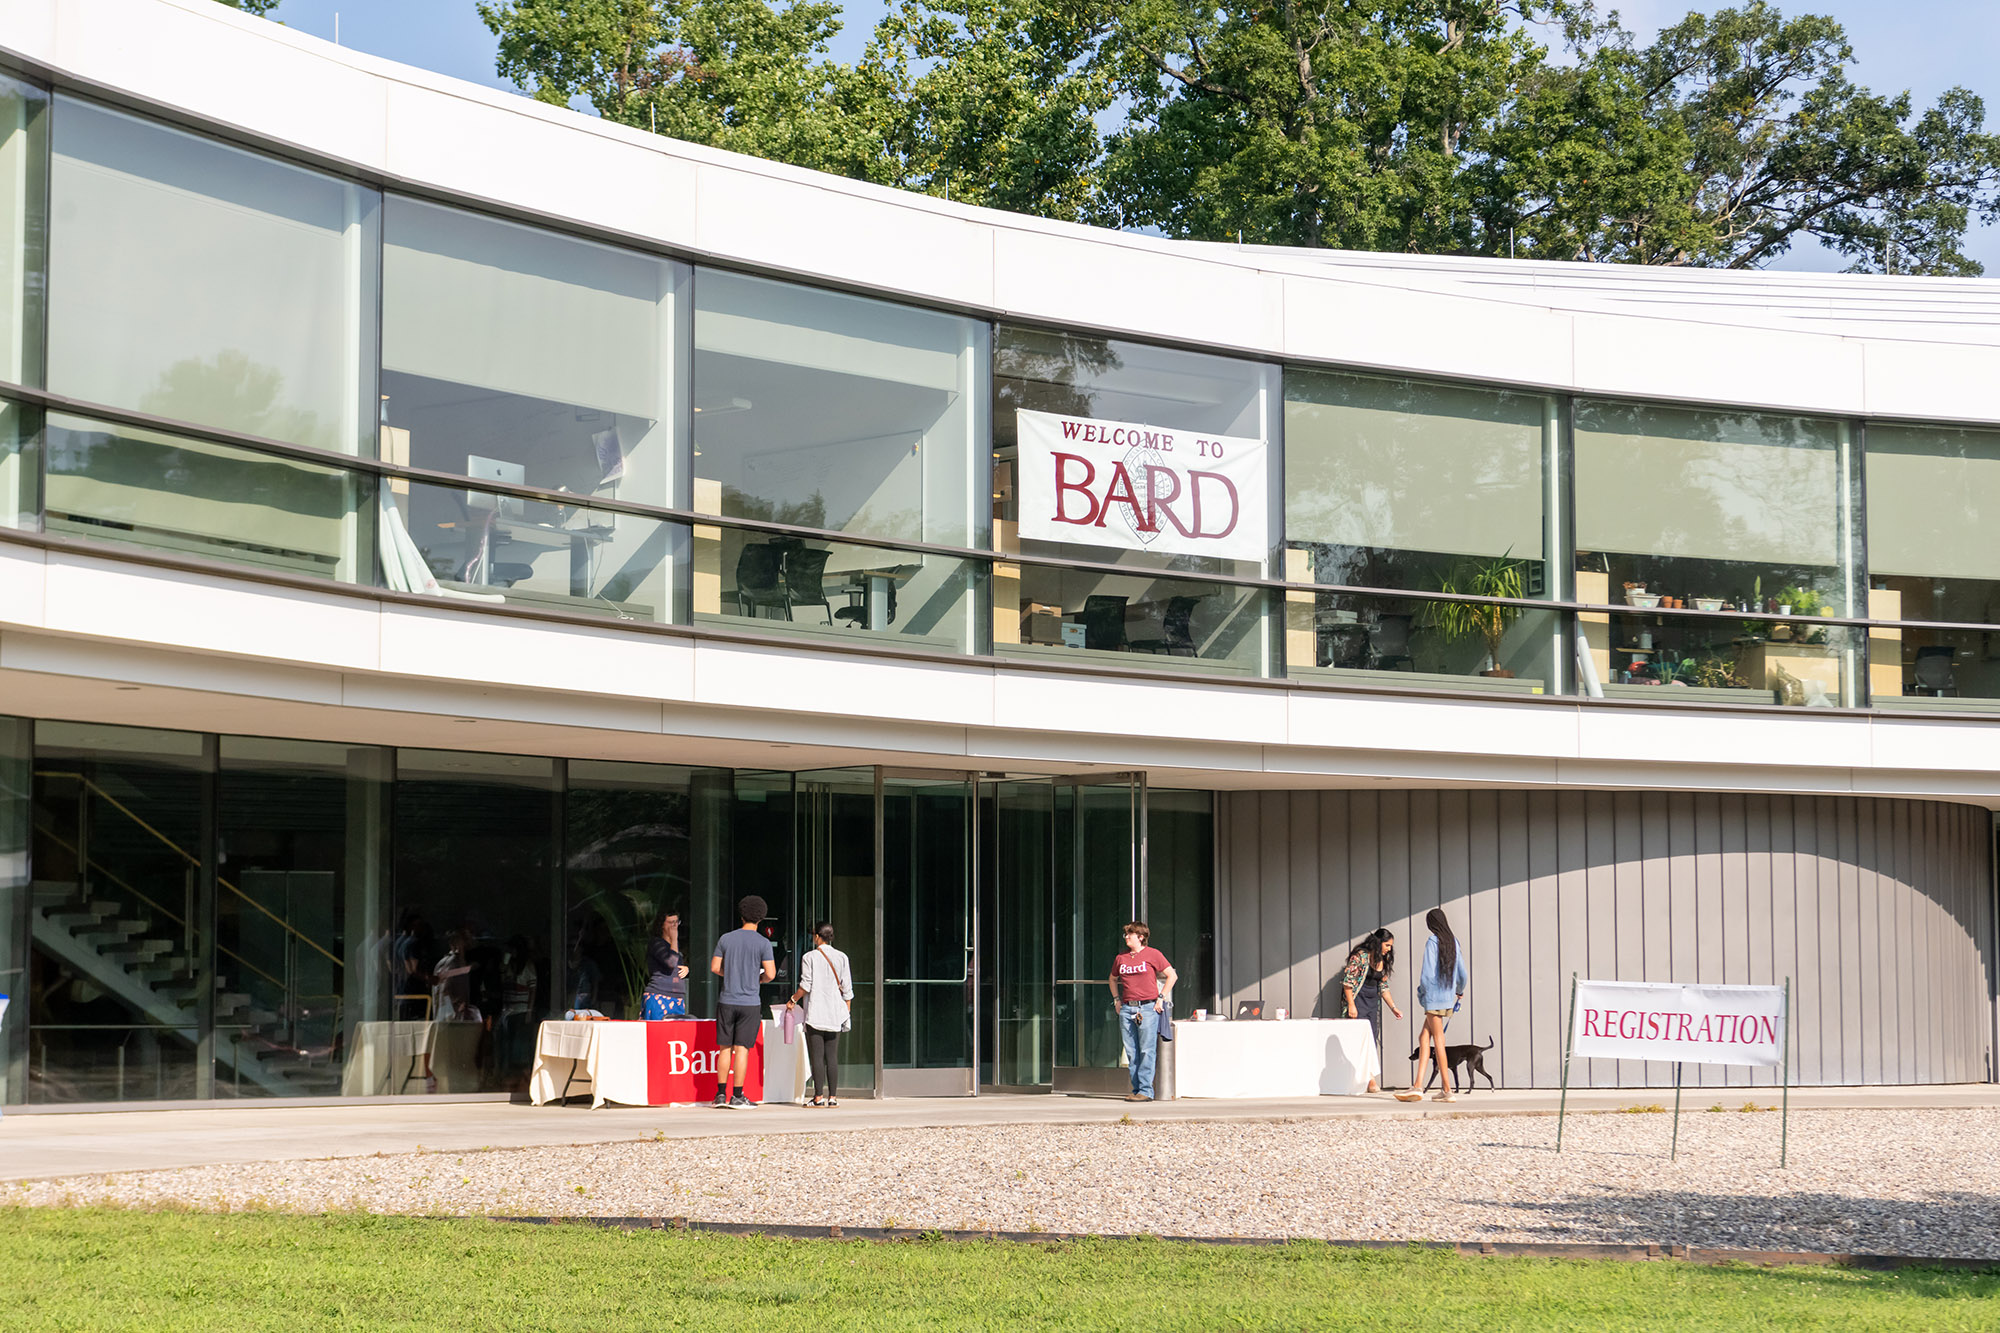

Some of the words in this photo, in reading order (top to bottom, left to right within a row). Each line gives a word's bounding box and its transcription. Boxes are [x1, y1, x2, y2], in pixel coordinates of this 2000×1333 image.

[1061, 420, 1174, 452] WELCOME
[1196, 439, 1224, 459] TO
[1050, 451, 1239, 539] BARD
[1119, 961, 1147, 974] Bard
[1582, 1008, 1779, 1045] REGISTRATION
[667, 1040, 736, 1075] Bar
